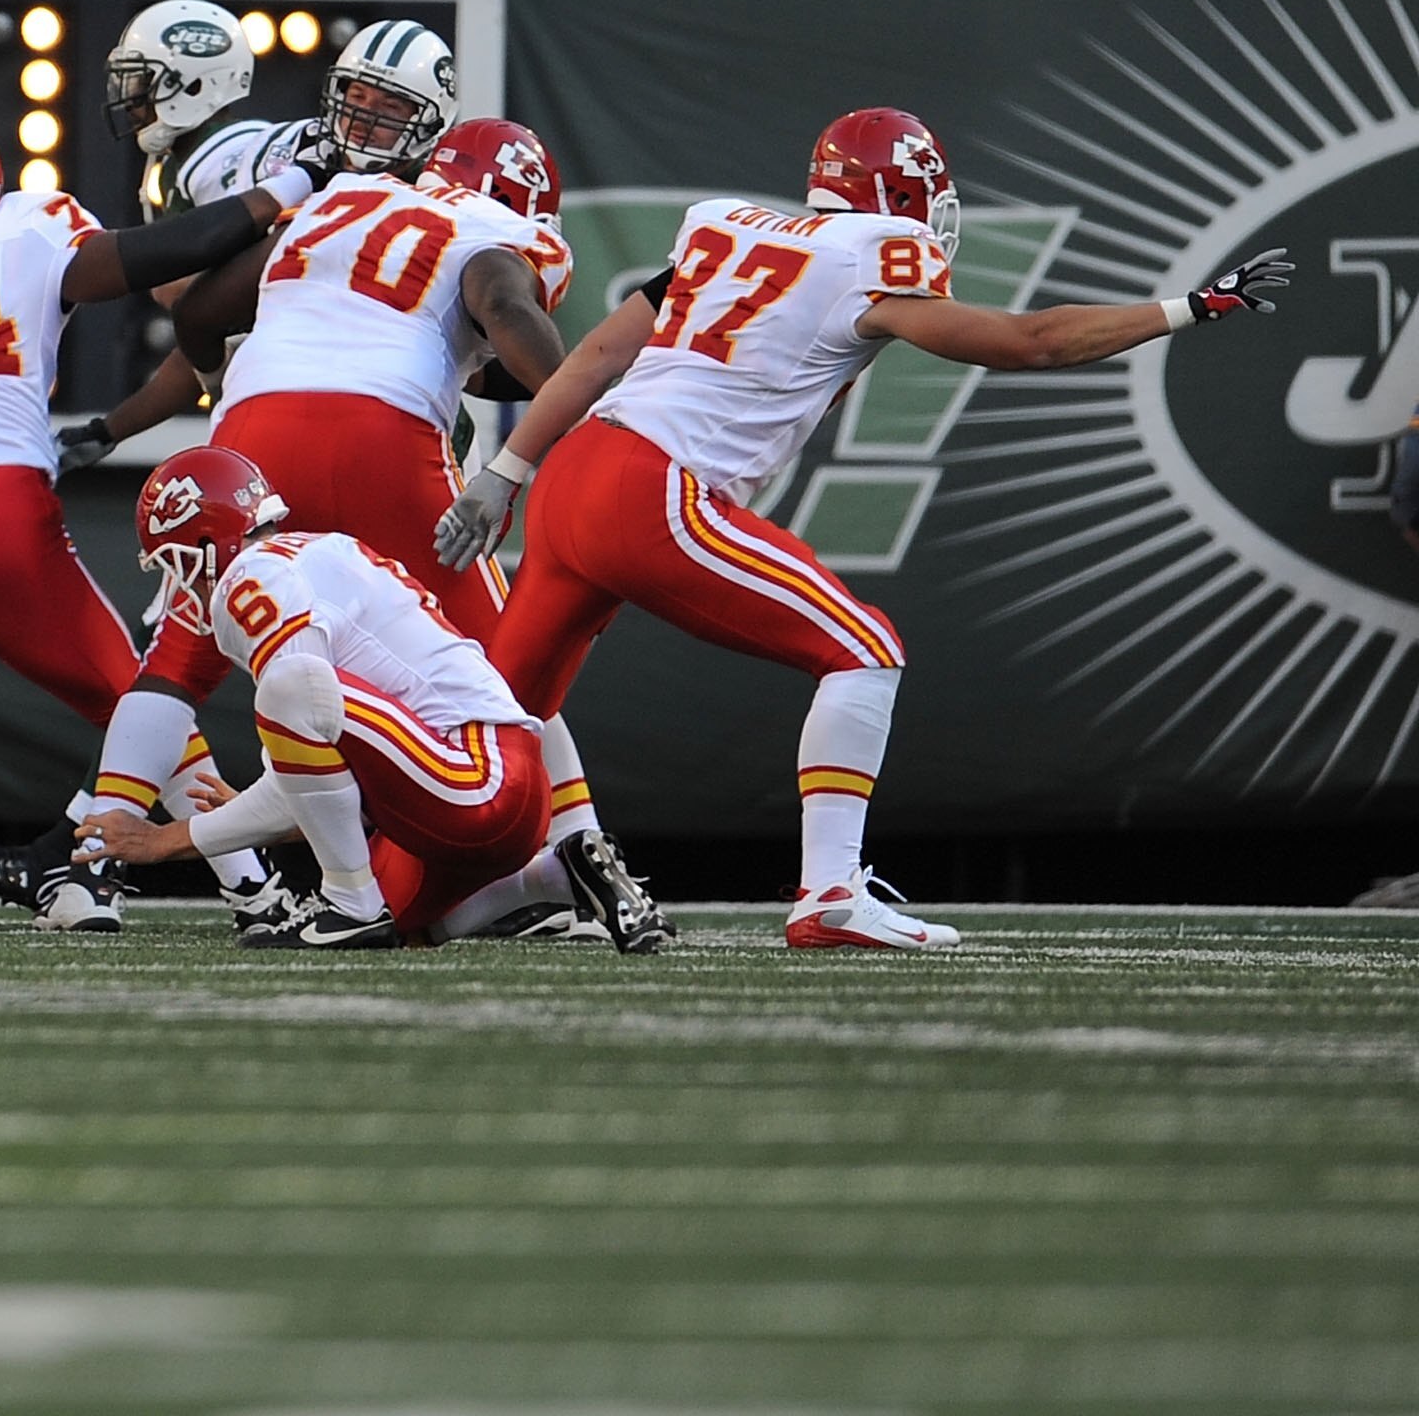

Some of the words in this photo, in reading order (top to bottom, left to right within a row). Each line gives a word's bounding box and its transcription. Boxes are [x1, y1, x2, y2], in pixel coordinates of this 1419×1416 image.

[266, 188, 459, 315] 70
[646, 224, 816, 366] 87
[224, 576, 282, 640] 6
